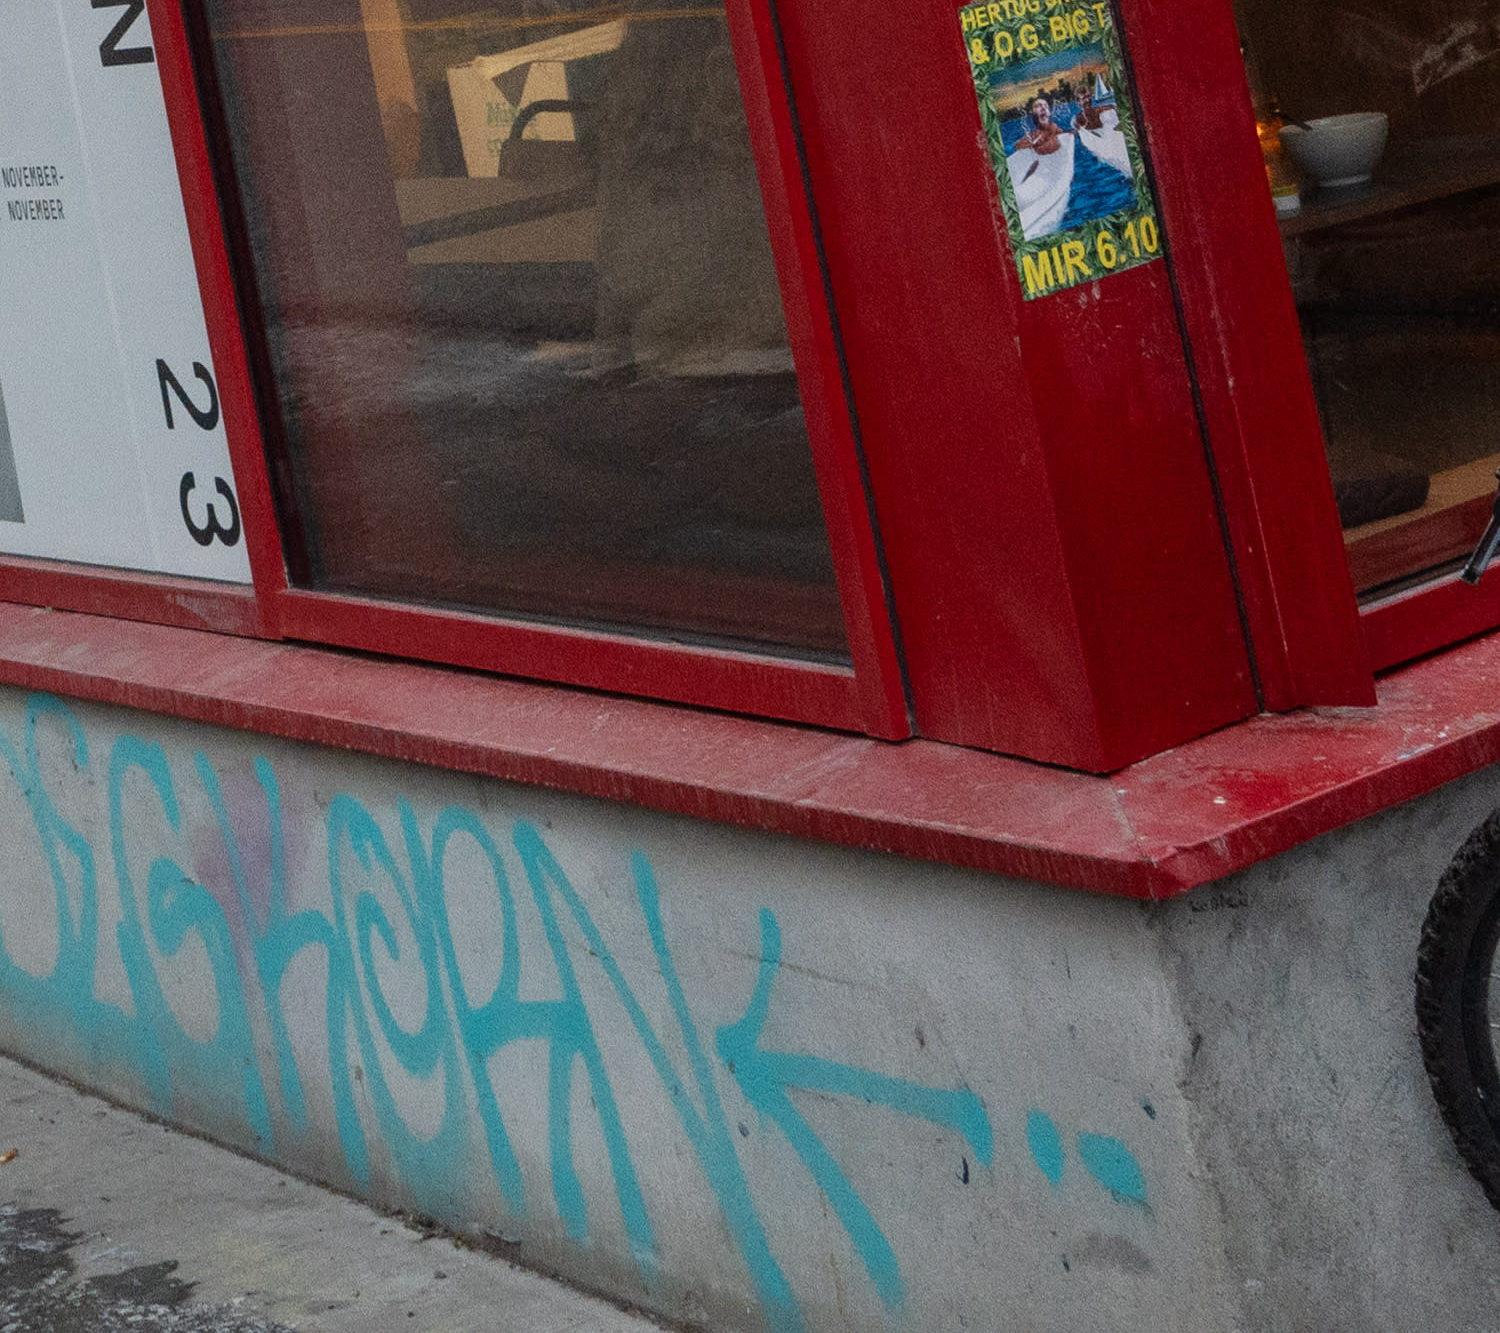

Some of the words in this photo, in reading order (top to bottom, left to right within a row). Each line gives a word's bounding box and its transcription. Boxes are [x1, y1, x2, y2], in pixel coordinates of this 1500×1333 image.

[969, 37, 991, 66] &
[994, 22, 1047, 60] O.G.
[1050, 7, 1089, 44] BIG
[1092, 2, 1106, 28] T
[1, 164, 66, 189] NOVEMBER-
[7, 198, 66, 222] NOVEMBER
[1021, 239, 1093, 295] MIR
[1096, 215, 1159, 270] 6.10
